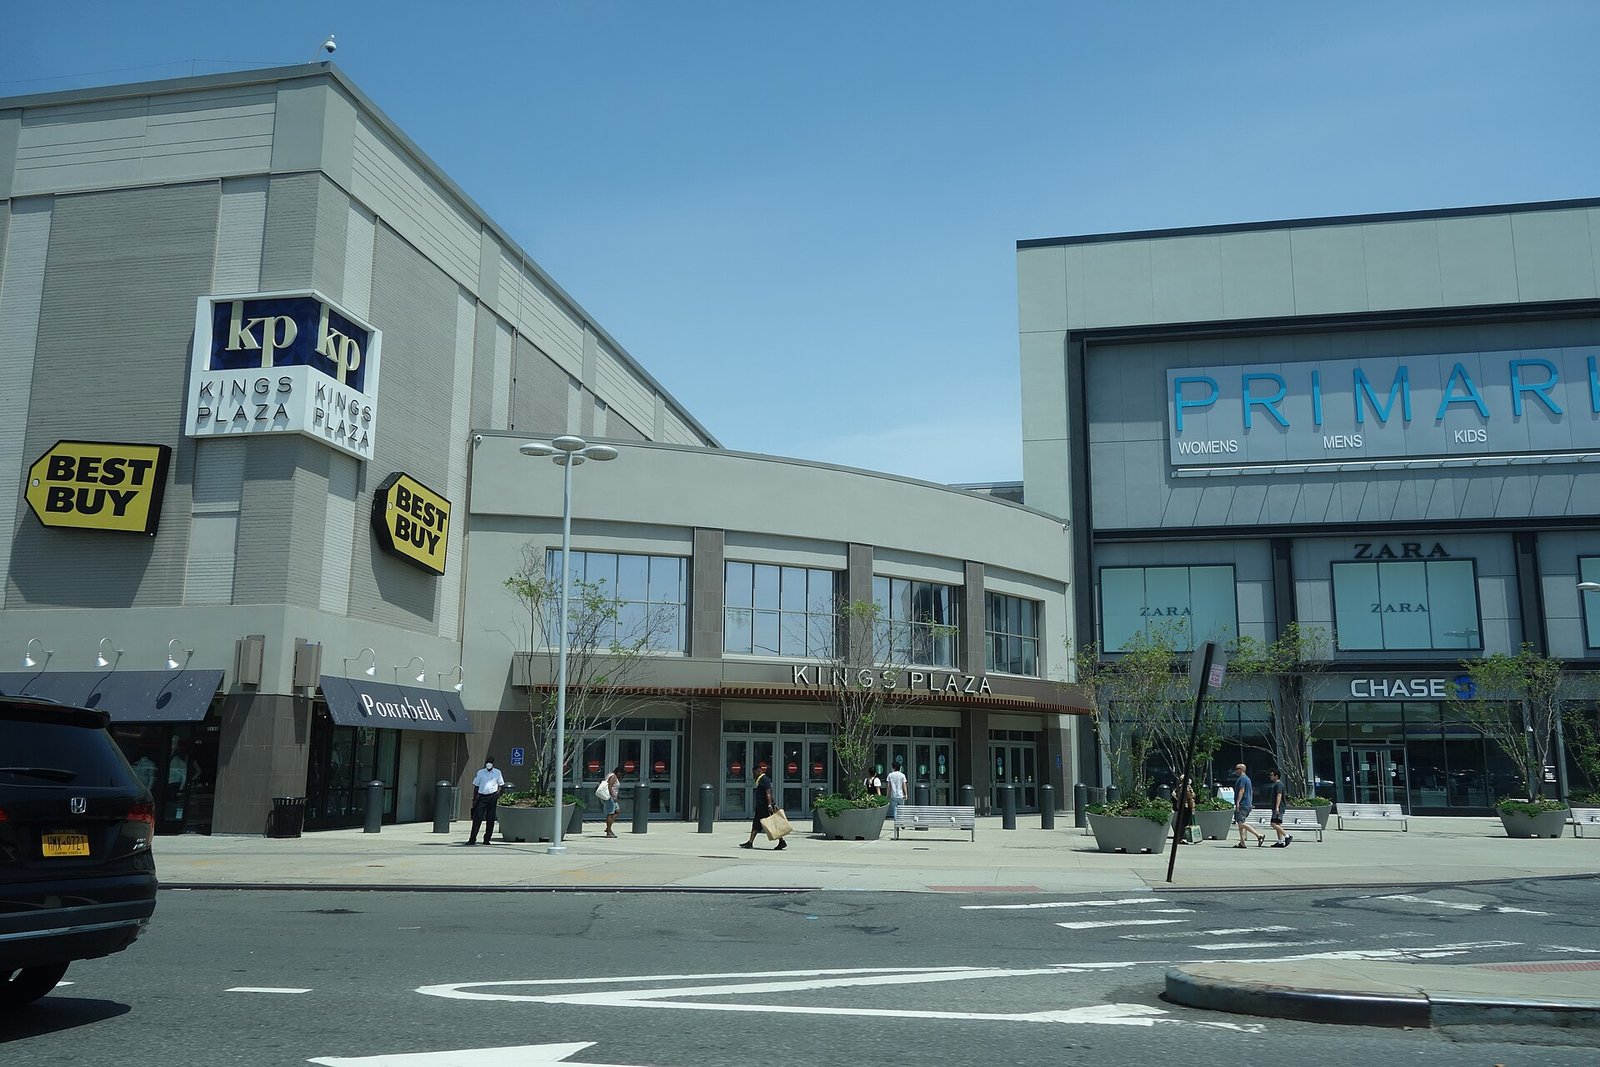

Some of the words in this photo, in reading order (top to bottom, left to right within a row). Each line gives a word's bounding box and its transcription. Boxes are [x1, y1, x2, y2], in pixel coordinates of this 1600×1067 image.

[200, 376, 293, 398] KINGS
[315, 381, 372, 422] KINGS
[197, 403, 290, 423] PLAZA
[313, 407, 370, 448] PLAZA
[1454, 429, 1487, 444] KIDS
[1177, 439, 1238, 455] WOMENS
[1323, 434, 1363, 449] MENS
[45, 455, 154, 486] BEST
[45, 486, 139, 517] BUY
[396, 485, 448, 533] BEST
[394, 513, 441, 557] BUY
[1354, 542, 1450, 559] ZARA
[1139, 606, 1193, 617] ZARA
[1370, 602, 1429, 613] ZARA
[792, 665, 897, 688] KINGS
[909, 672, 992, 694] PLAZA
[1350, 678, 1446, 698] CHASE
